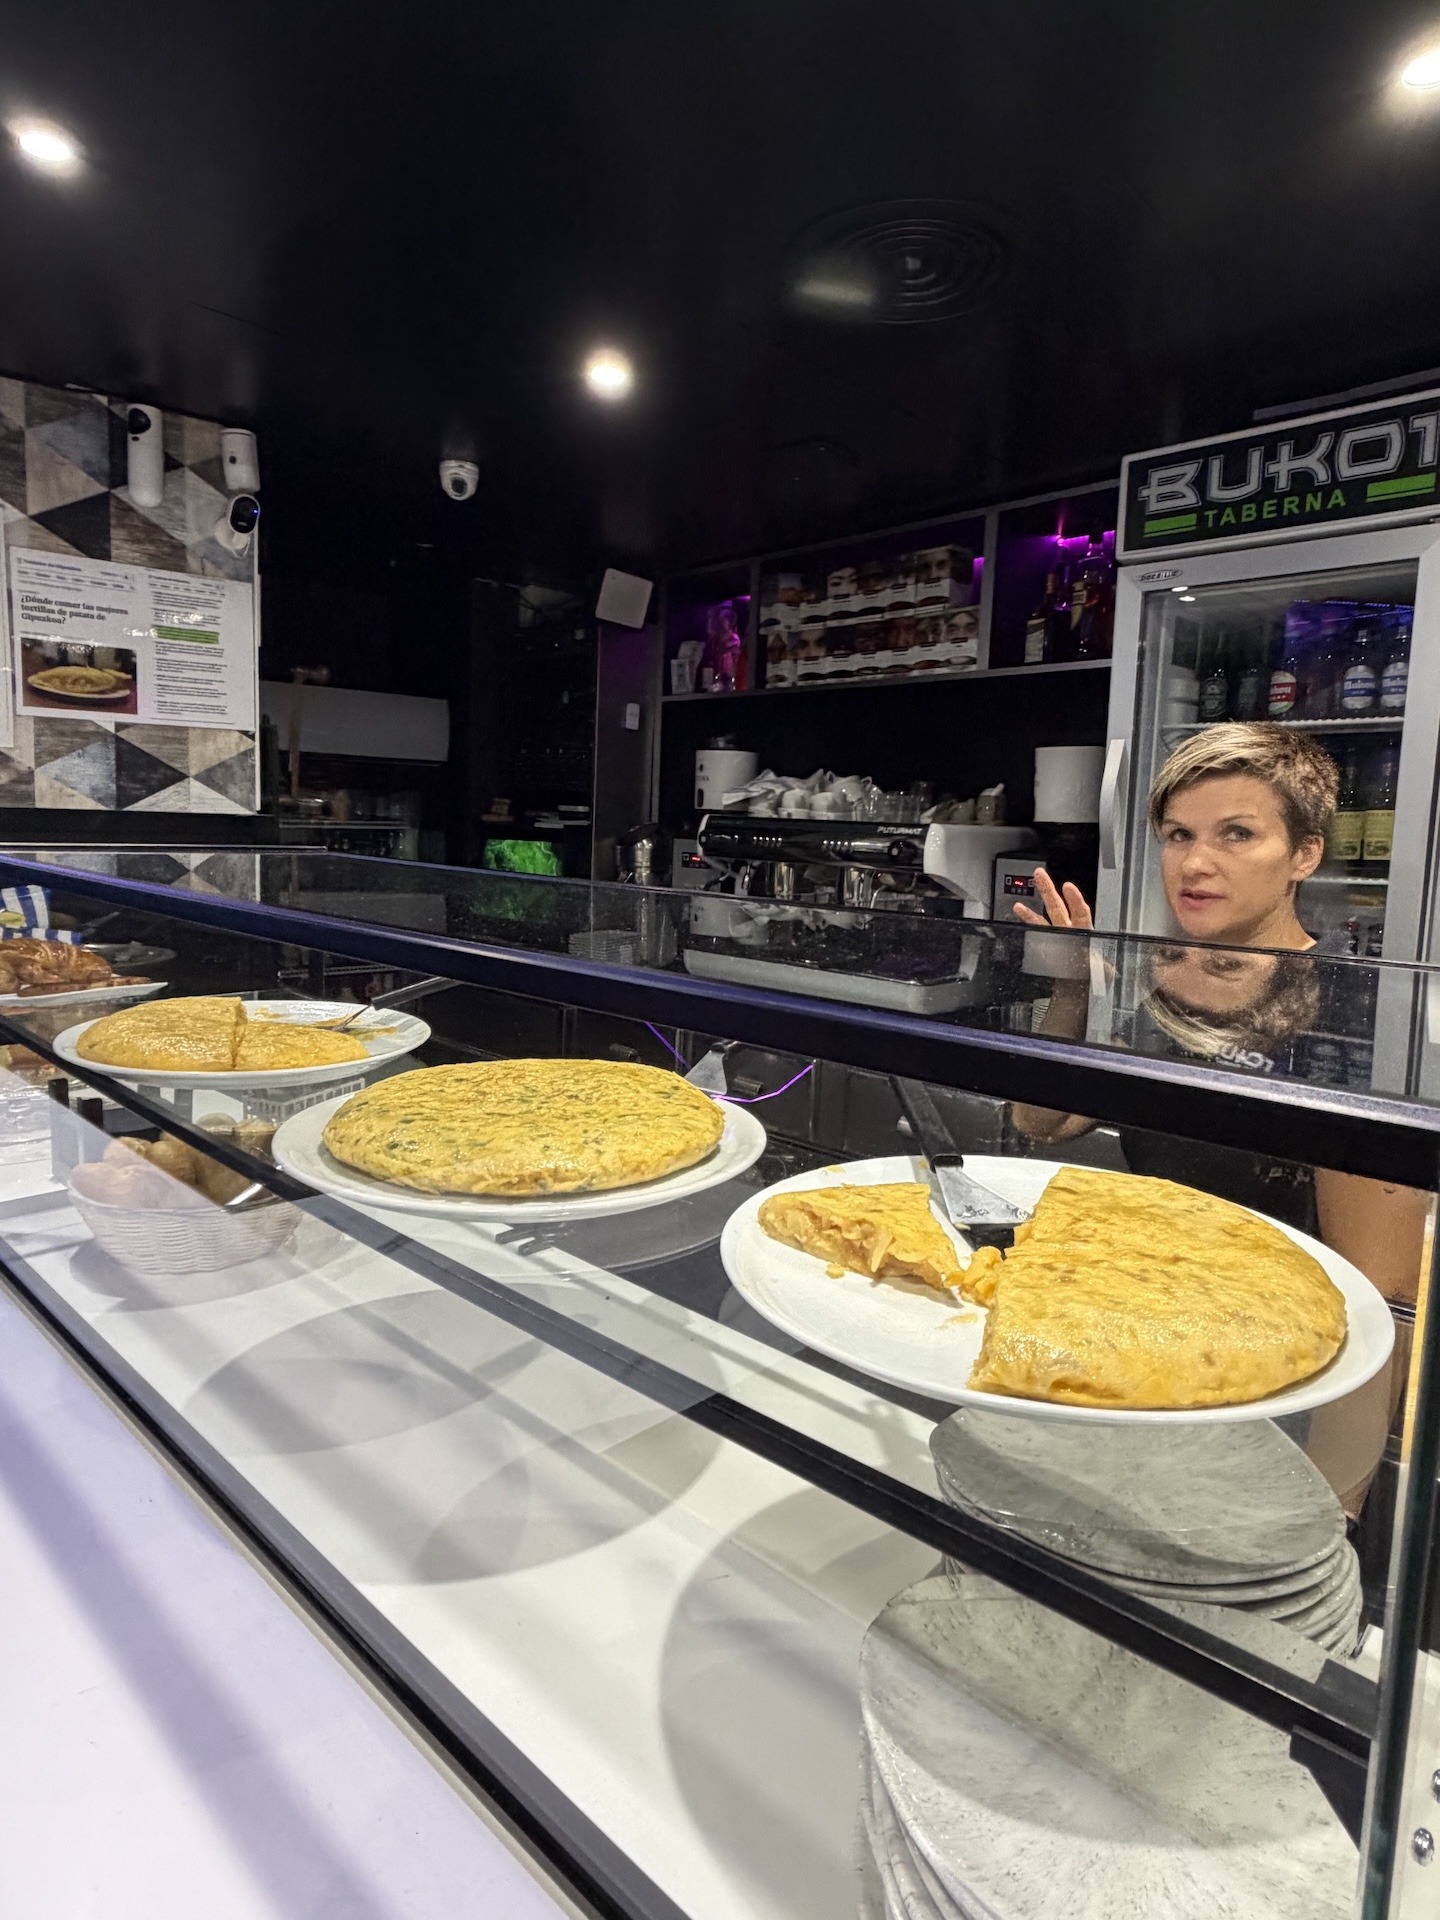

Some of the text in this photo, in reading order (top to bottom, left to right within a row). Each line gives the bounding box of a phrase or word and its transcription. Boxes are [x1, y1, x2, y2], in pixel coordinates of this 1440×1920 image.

[1138, 411, 1440, 515] BUKO1
[1204, 488, 1347, 529] TABERNA
[21, 604, 106, 621] tortillas de patata de
[21, 613, 66, 624] Gipuzkoa?
